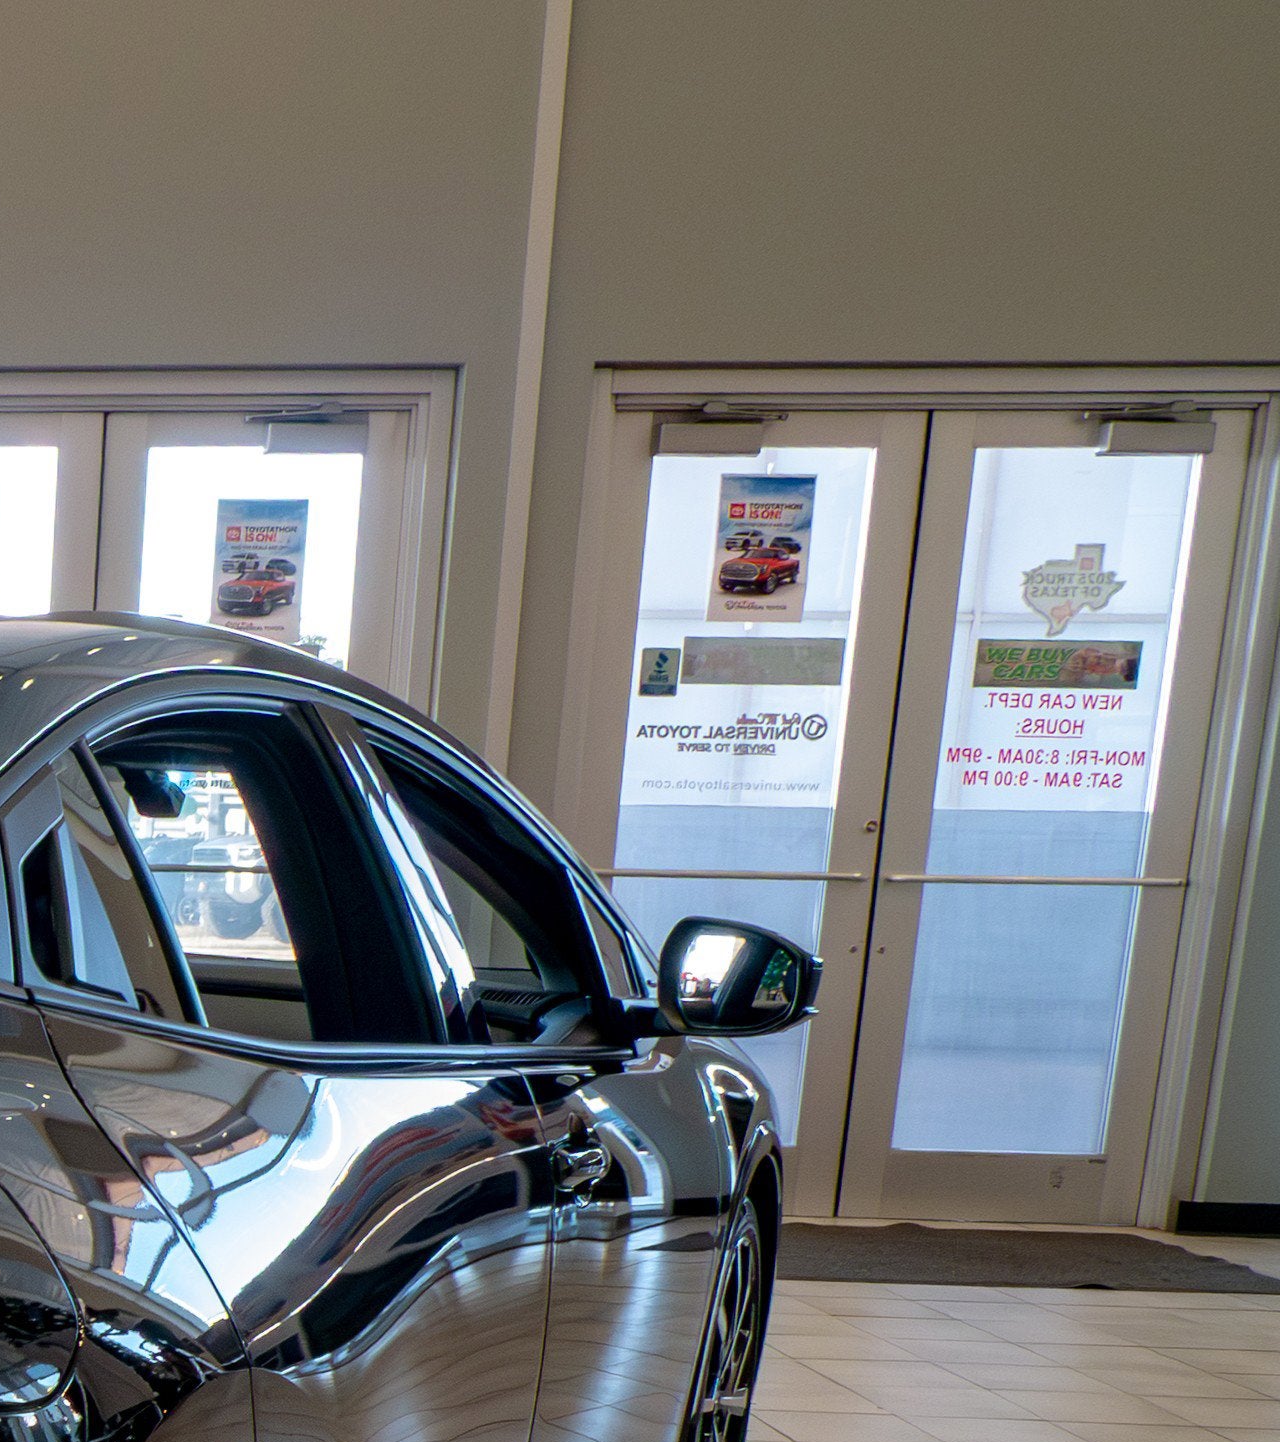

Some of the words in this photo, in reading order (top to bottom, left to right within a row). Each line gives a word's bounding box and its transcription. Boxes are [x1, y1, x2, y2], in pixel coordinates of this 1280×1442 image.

[244, 525, 298, 533] TOYOTATHON
[244, 533, 255, 543] IS
[254, 533, 277, 543] ON!
[986, 647, 1025, 664] WE
[1026, 647, 1076, 663] BUY
[992, 664, 1062, 681] CARS
